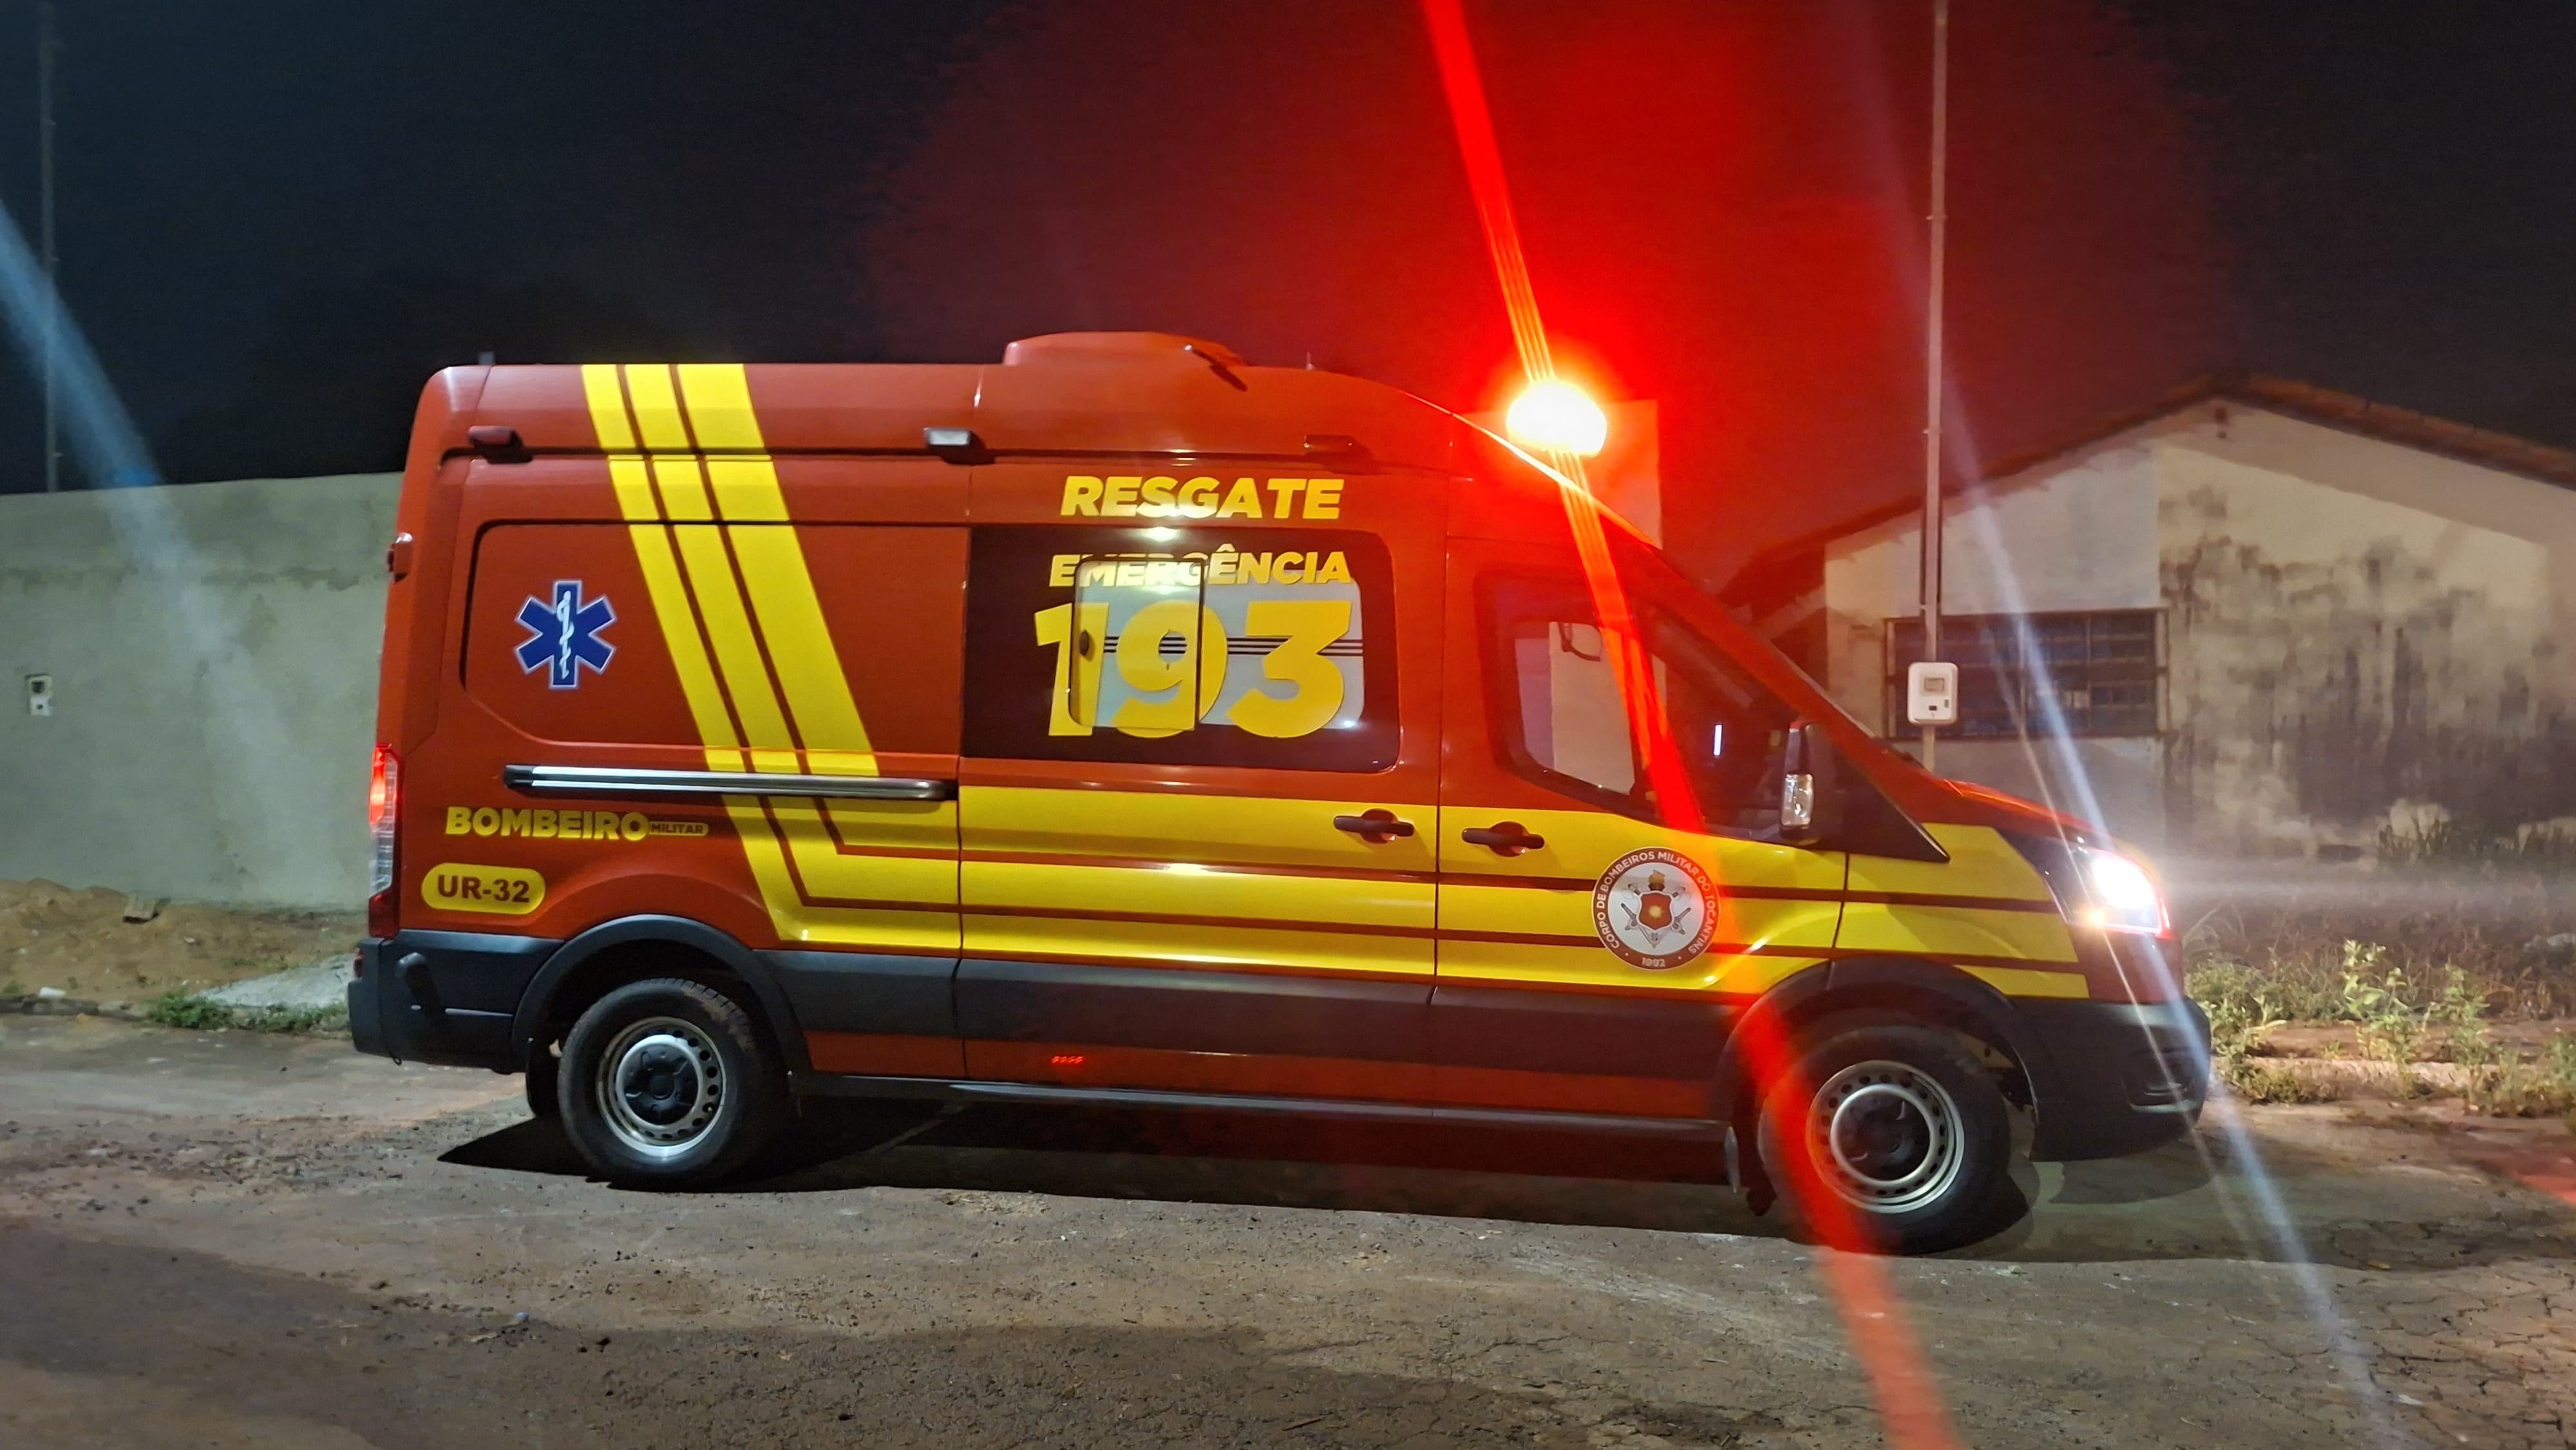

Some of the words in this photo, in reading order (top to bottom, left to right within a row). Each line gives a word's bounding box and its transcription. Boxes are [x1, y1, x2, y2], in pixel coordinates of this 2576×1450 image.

[1060, 475, 1345, 520] RESGATE
[1048, 543, 1352, 588] EMERGÊNCIA
[1034, 599, 1351, 739] 193
[445, 806, 649, 841] BOMBEIRO
[650, 823, 704, 834] MILITAR
[1600, 851, 1655, 892] BOMBEIROS
[1658, 851, 1700, 876] MILITAR
[438, 874, 530, 903] UR-32
[1596, 893, 1606, 909] DE
[1697, 874, 1711, 891] DO
[1596, 912, 1620, 949] CORPO
[1688, 892, 1716, 954] TOCANTINS
